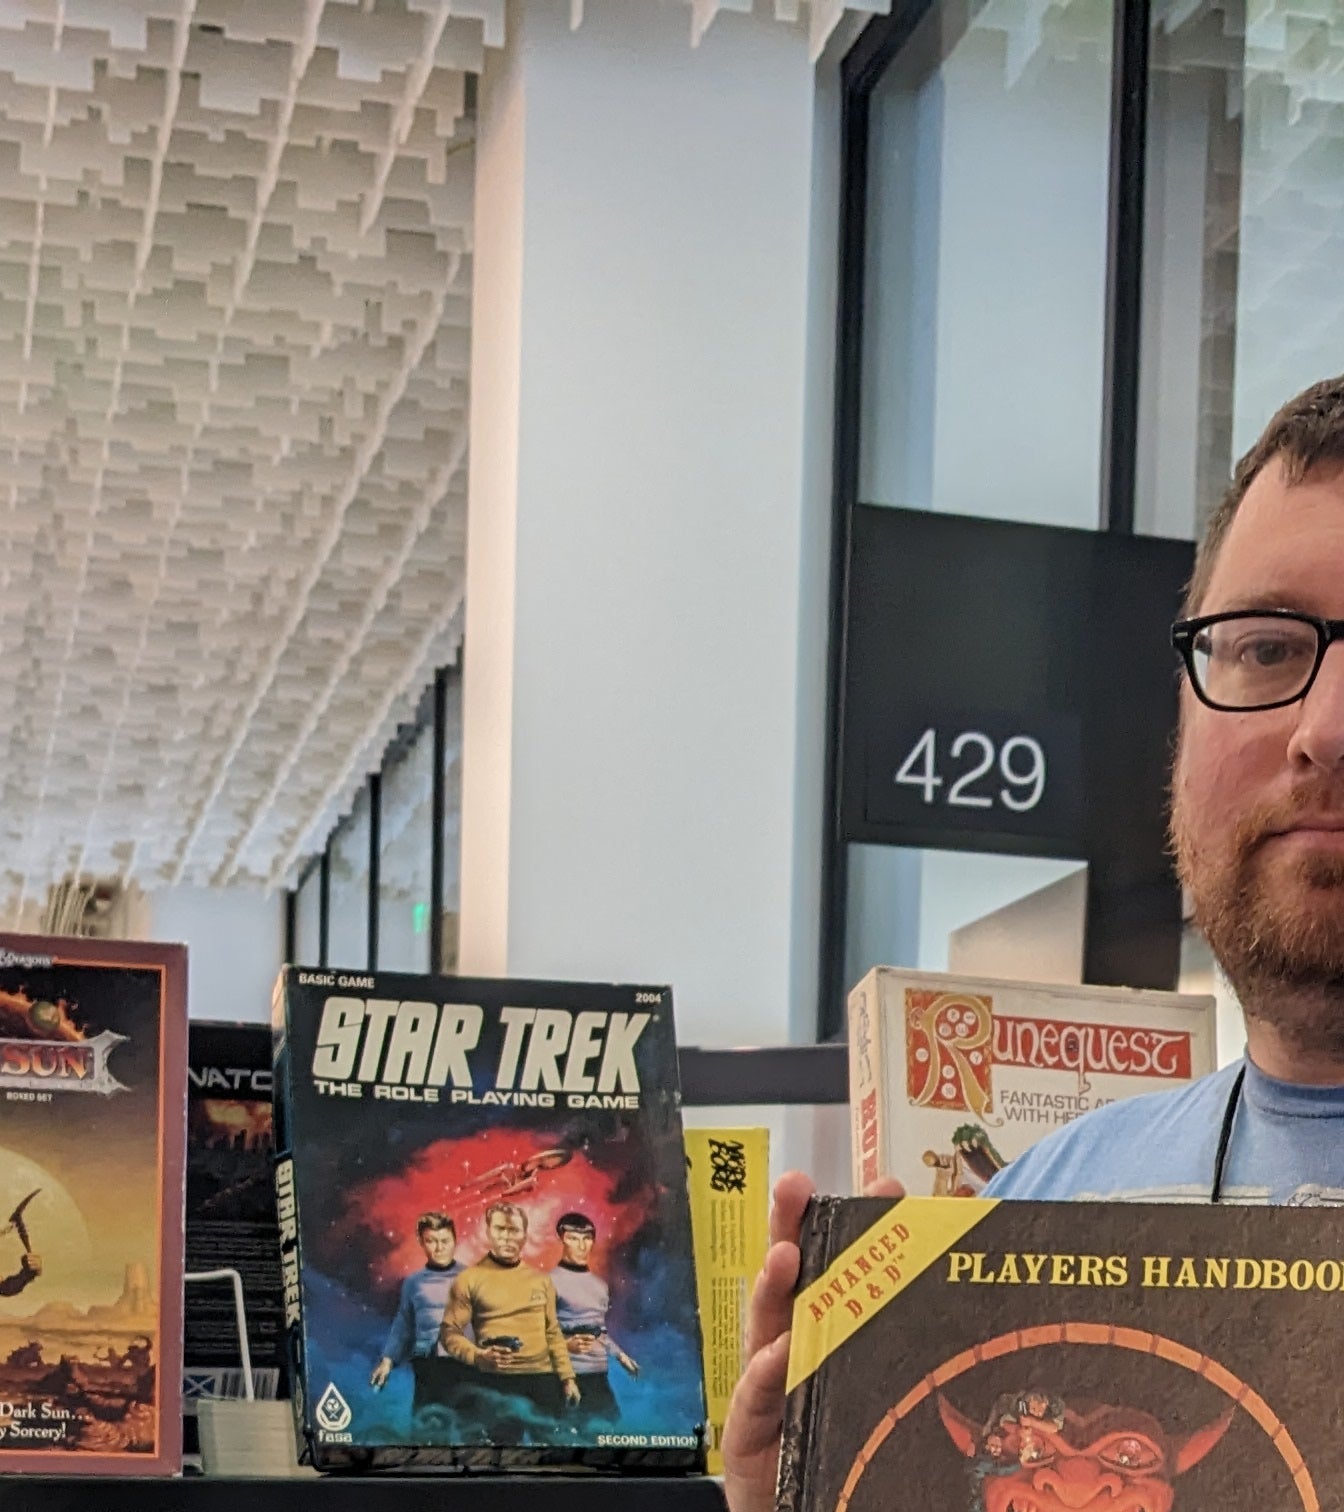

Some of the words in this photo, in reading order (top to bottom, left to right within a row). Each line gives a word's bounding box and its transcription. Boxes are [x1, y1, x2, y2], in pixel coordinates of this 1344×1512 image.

[894, 728, 1047, 812] 429
[299, 973, 335, 987] BASIC
[338, 976, 375, 988] GAME
[312, 996, 484, 1089] STAR
[496, 1007, 653, 1094] TREK
[0, 1047, 89, 1080] SUN
[36, 1093, 52, 1102] SET
[314, 1080, 363, 1097] THE
[374, 1084, 439, 1101] ROLE
[451, 1089, 555, 1107] PLAYING
[567, 1094, 640, 1109] GAME
[1000, 1090, 1090, 1111] FANTASTIC
[1004, 1107, 1050, 1123] WITH
[809, 1221, 913, 1322] ADVANCED
[947, 1252, 1128, 1286] PLAYERS
[0, 1403, 34, 1419] Dark
[9, 1422, 66, 1439] Sorcery!
[318, 1430, 353, 1443] fasa
[598, 1434, 647, 1446] SECOND
[651, 1434, 698, 1447] EDITION
